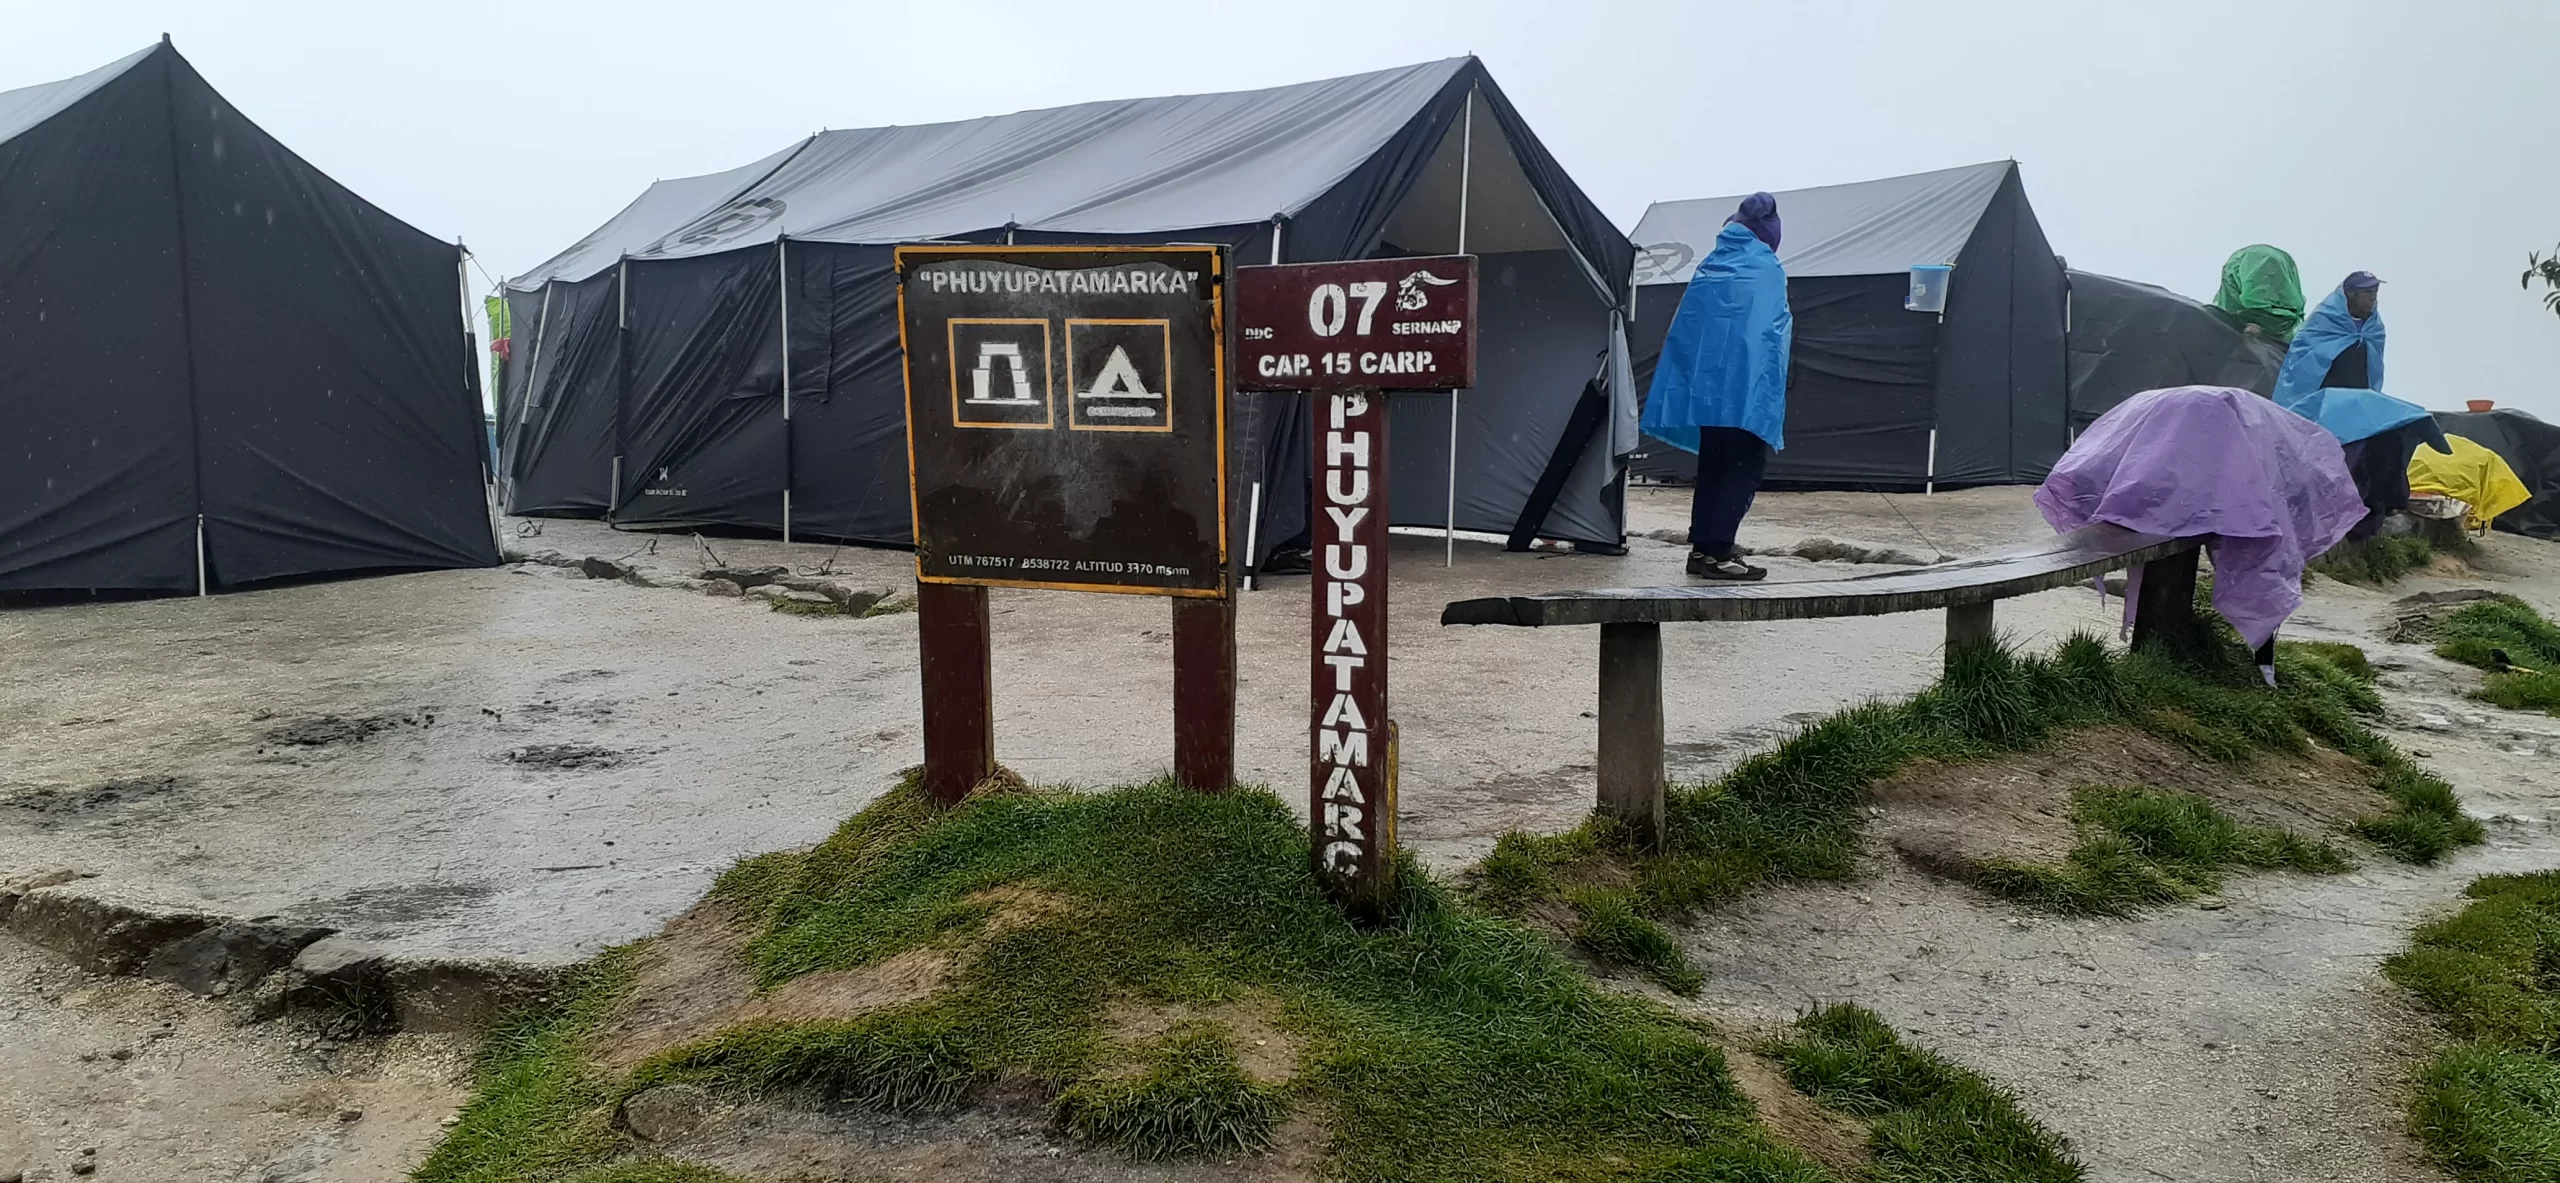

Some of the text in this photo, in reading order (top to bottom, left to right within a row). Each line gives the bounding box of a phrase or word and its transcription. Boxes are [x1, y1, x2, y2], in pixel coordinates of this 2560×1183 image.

[1309, 282, 1388, 336] 07
[1258, 350, 1436, 377] CAP. 15 CARP.
[949, 555, 973, 566] UTM
[976, 556, 1015, 568] 767517
[1021, 558, 1070, 570] 8538722
[1075, 560, 1123, 573] ALTITUD
